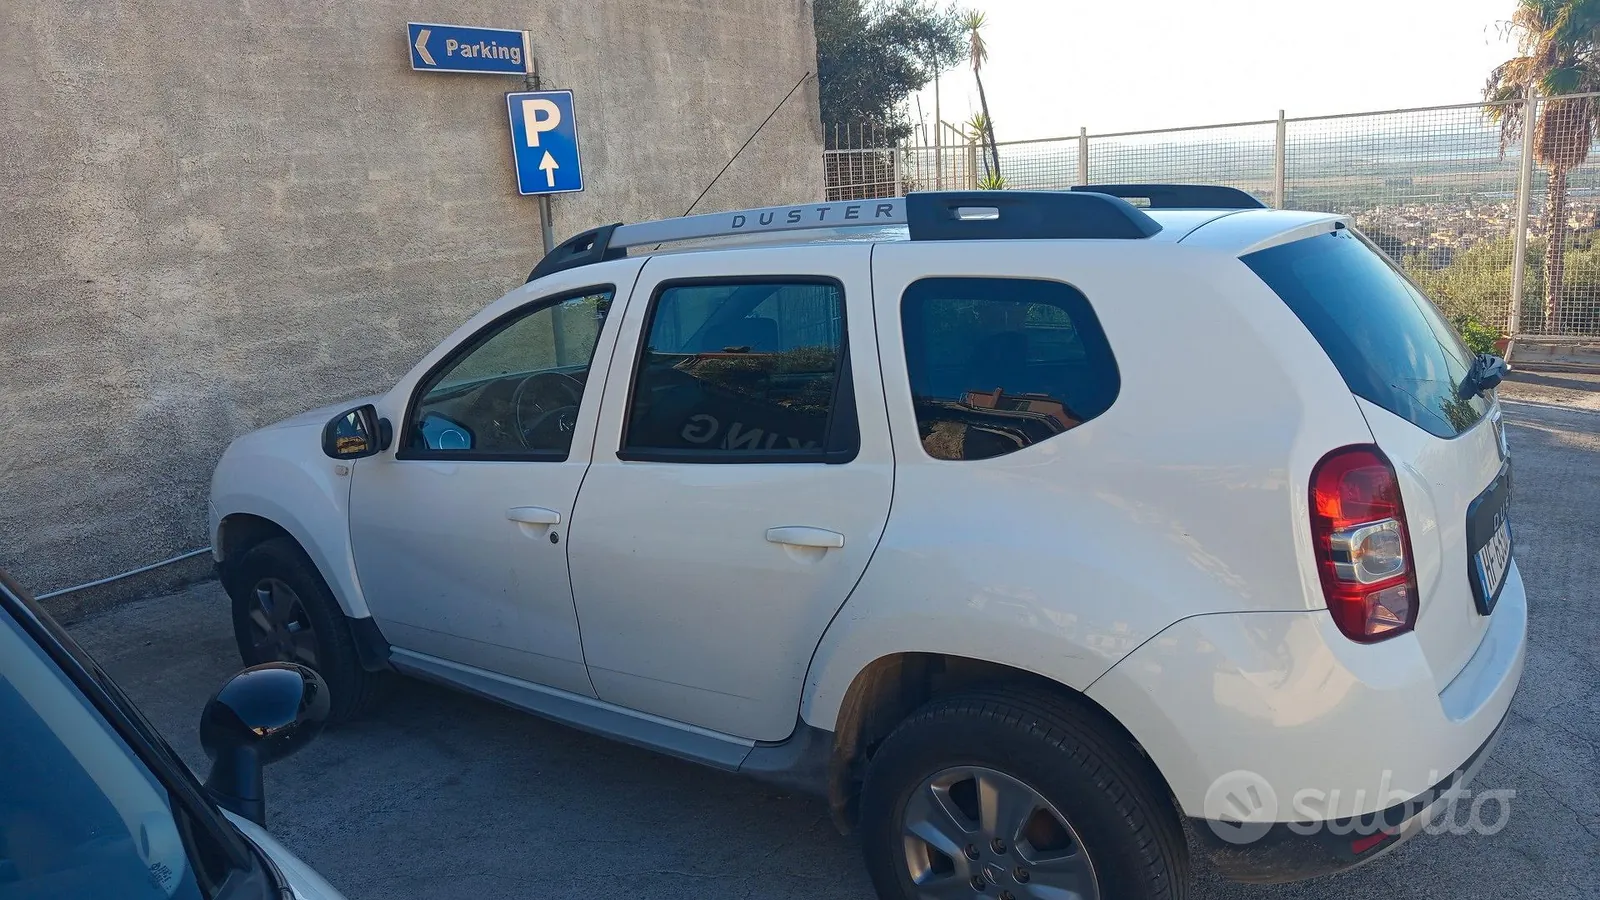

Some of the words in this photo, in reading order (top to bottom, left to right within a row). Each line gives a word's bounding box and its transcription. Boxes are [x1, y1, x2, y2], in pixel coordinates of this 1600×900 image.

[446, 39, 521, 65] Parking
[521, 98, 561, 147] P
[731, 203, 893, 229] DUSTER
